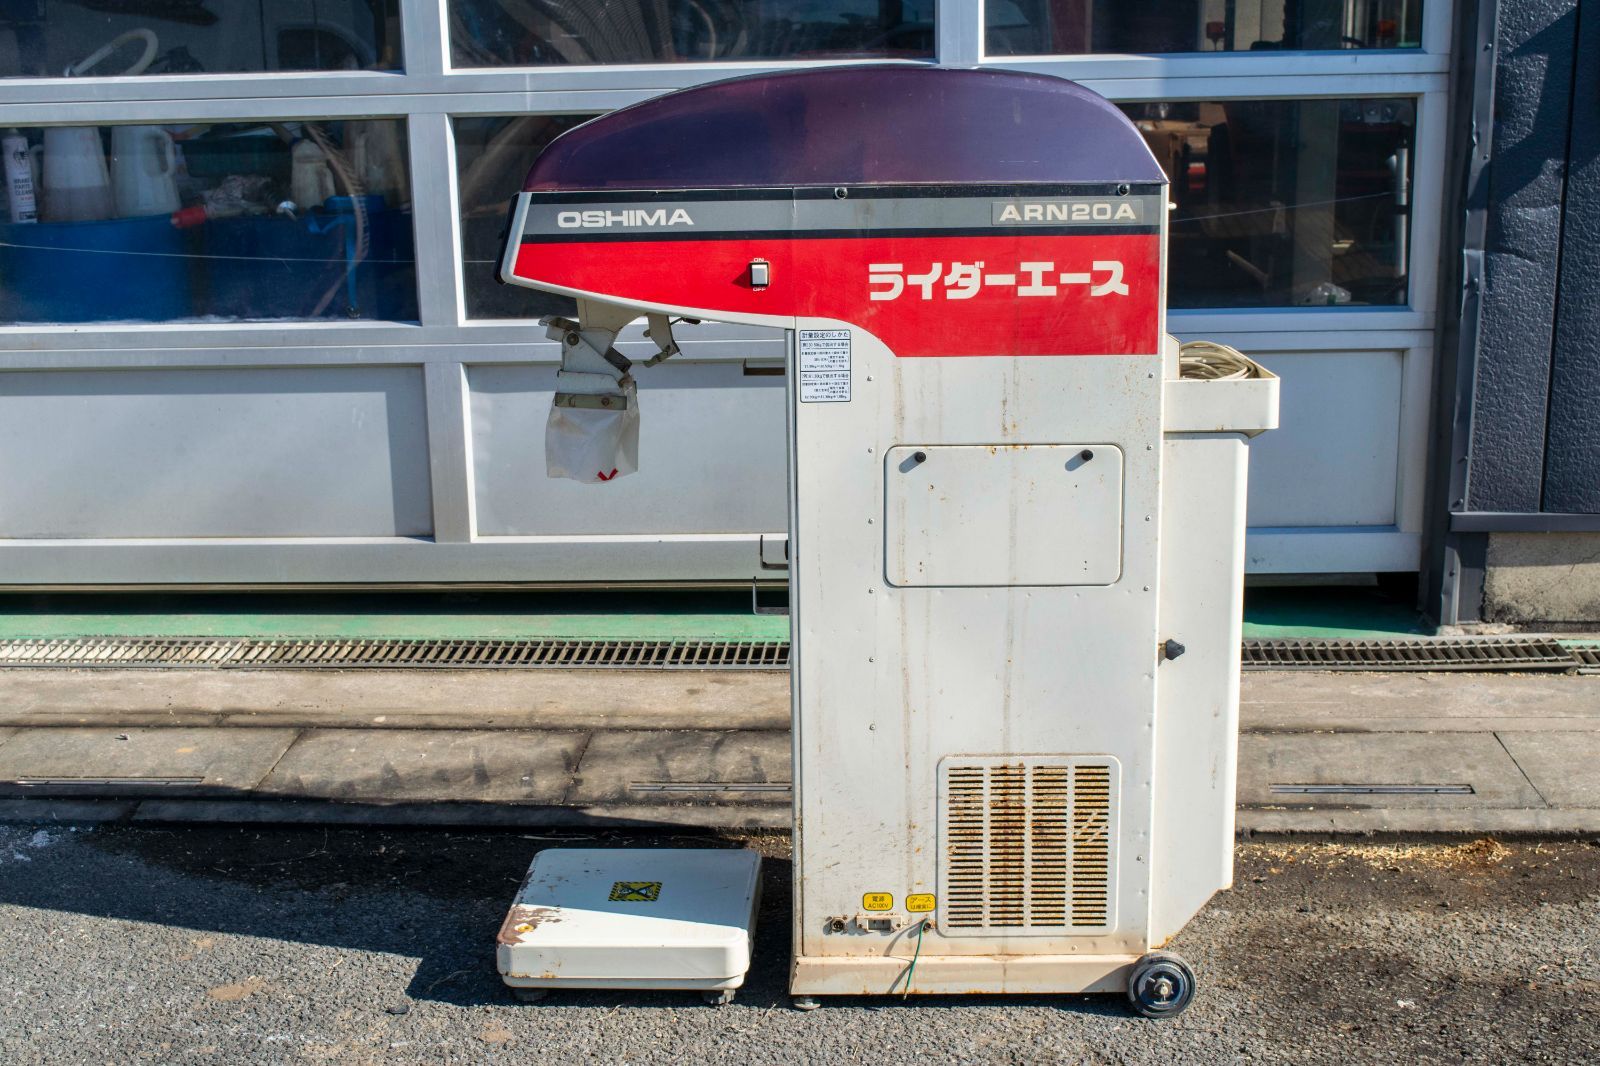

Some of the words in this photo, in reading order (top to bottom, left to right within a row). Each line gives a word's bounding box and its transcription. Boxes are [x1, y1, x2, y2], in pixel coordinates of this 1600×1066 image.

[557, 208, 695, 228] OSHIMA
[999, 203, 1137, 221] ARN20A
[868, 260, 1129, 301] ライダーエース
[801, 331, 849, 339] 計量設定のしかた
